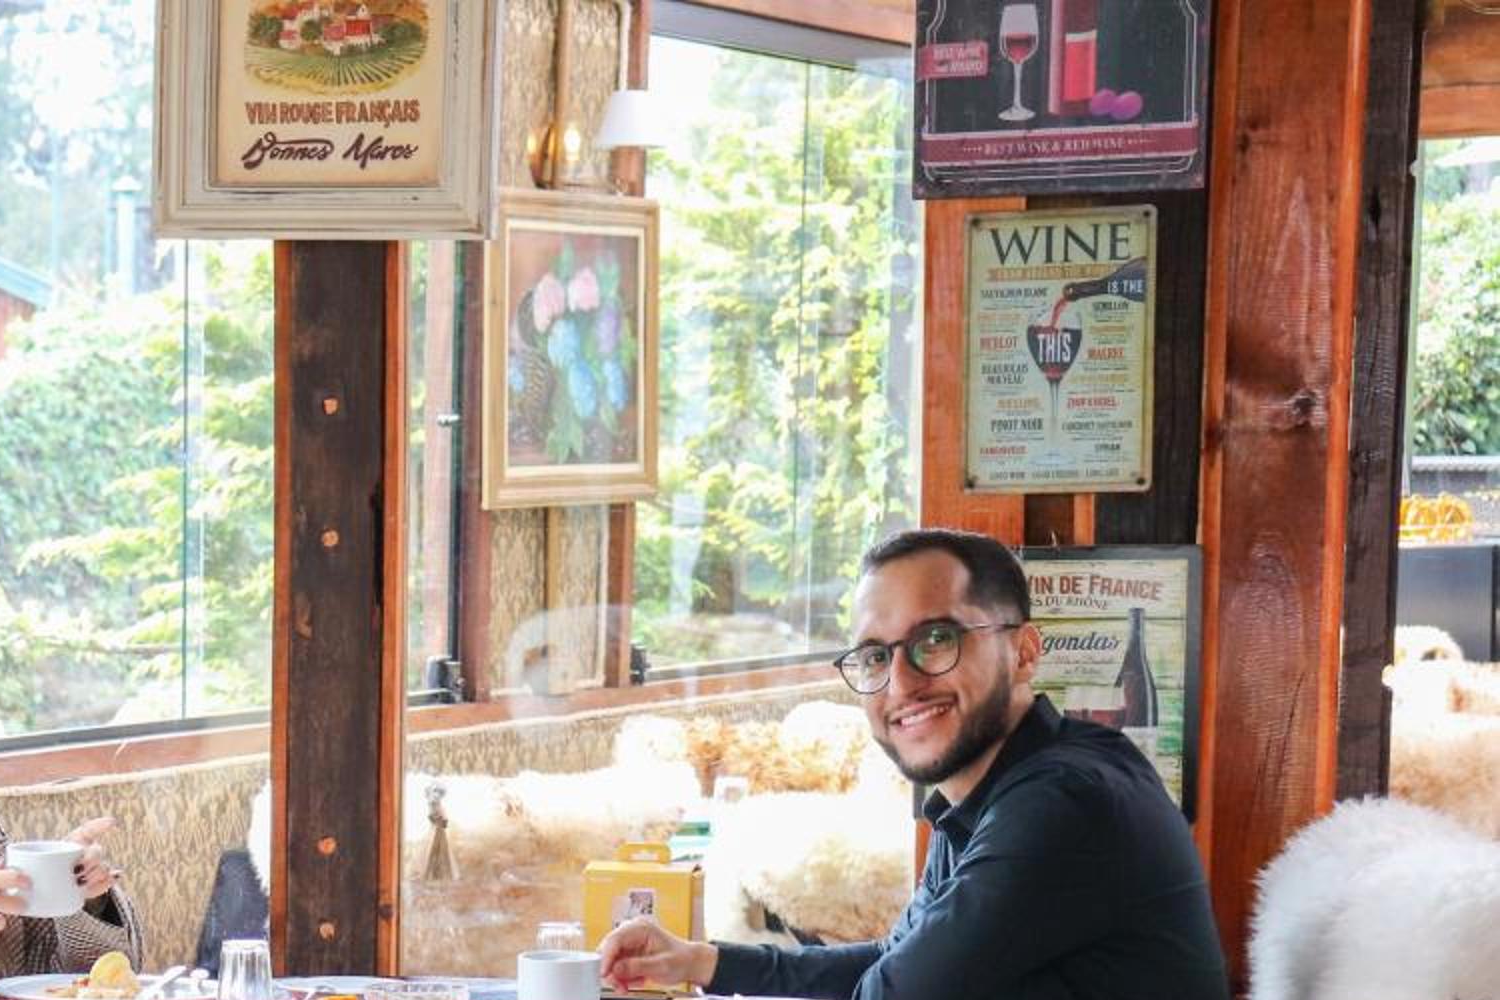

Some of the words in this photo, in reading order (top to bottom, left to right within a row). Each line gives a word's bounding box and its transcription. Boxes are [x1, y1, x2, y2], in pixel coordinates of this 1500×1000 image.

[245, 102, 277, 125] VIN
[280, 101, 333, 125] ROUGE
[335, 99, 421, 128] FRANÇAIS
[241, 131, 335, 170] Bonnes
[990, 221, 1132, 265] WINE
[1107, 280, 1119, 294] IS
[1122, 279, 1144, 294] THE
[1037, 332, 1073, 364] THIS
[1059, 575, 1083, 595] DE
[1089, 574, 1164, 601] FRANCE
